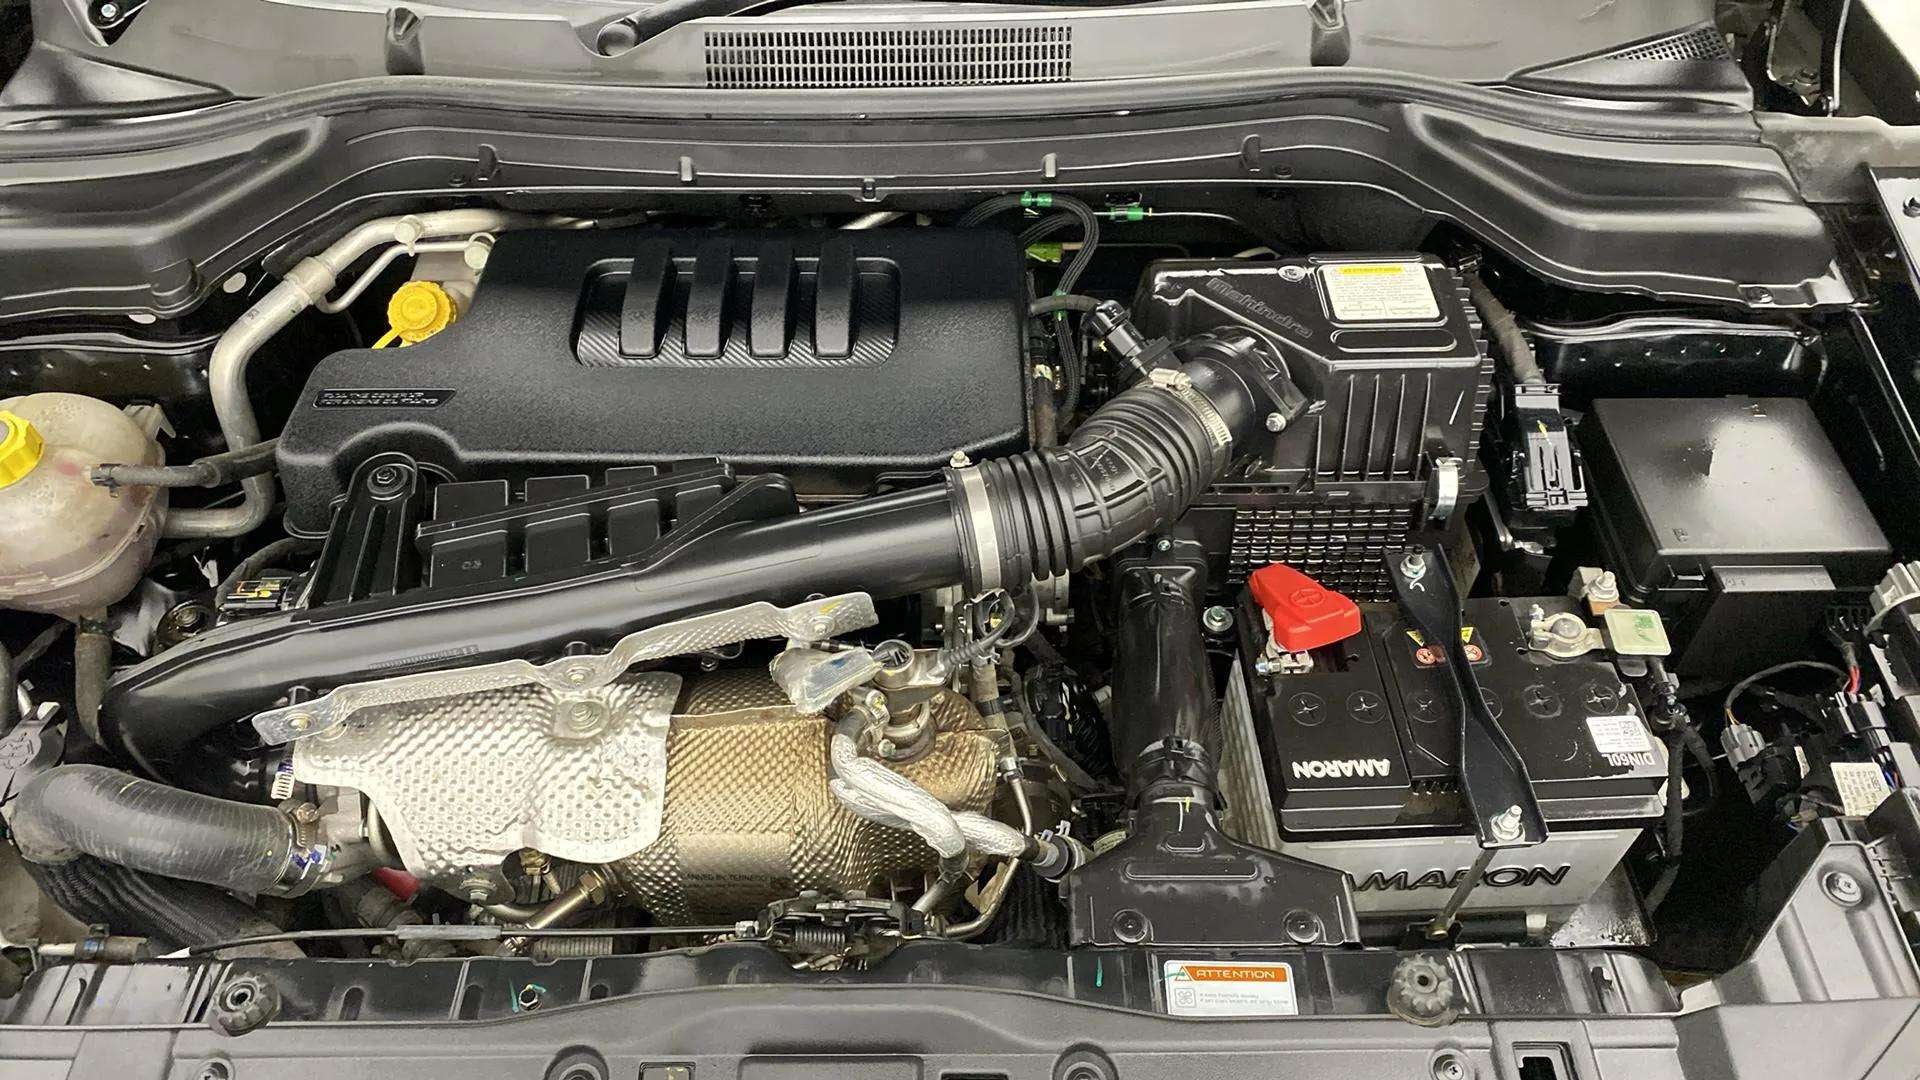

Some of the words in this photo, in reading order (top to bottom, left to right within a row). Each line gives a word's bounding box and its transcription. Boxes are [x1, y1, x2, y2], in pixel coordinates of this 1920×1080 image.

[1601, 752, 1656, 766] DIN60L
[1291, 758, 1391, 779] AMARON
[1195, 969, 1276, 979] ATTENTION
